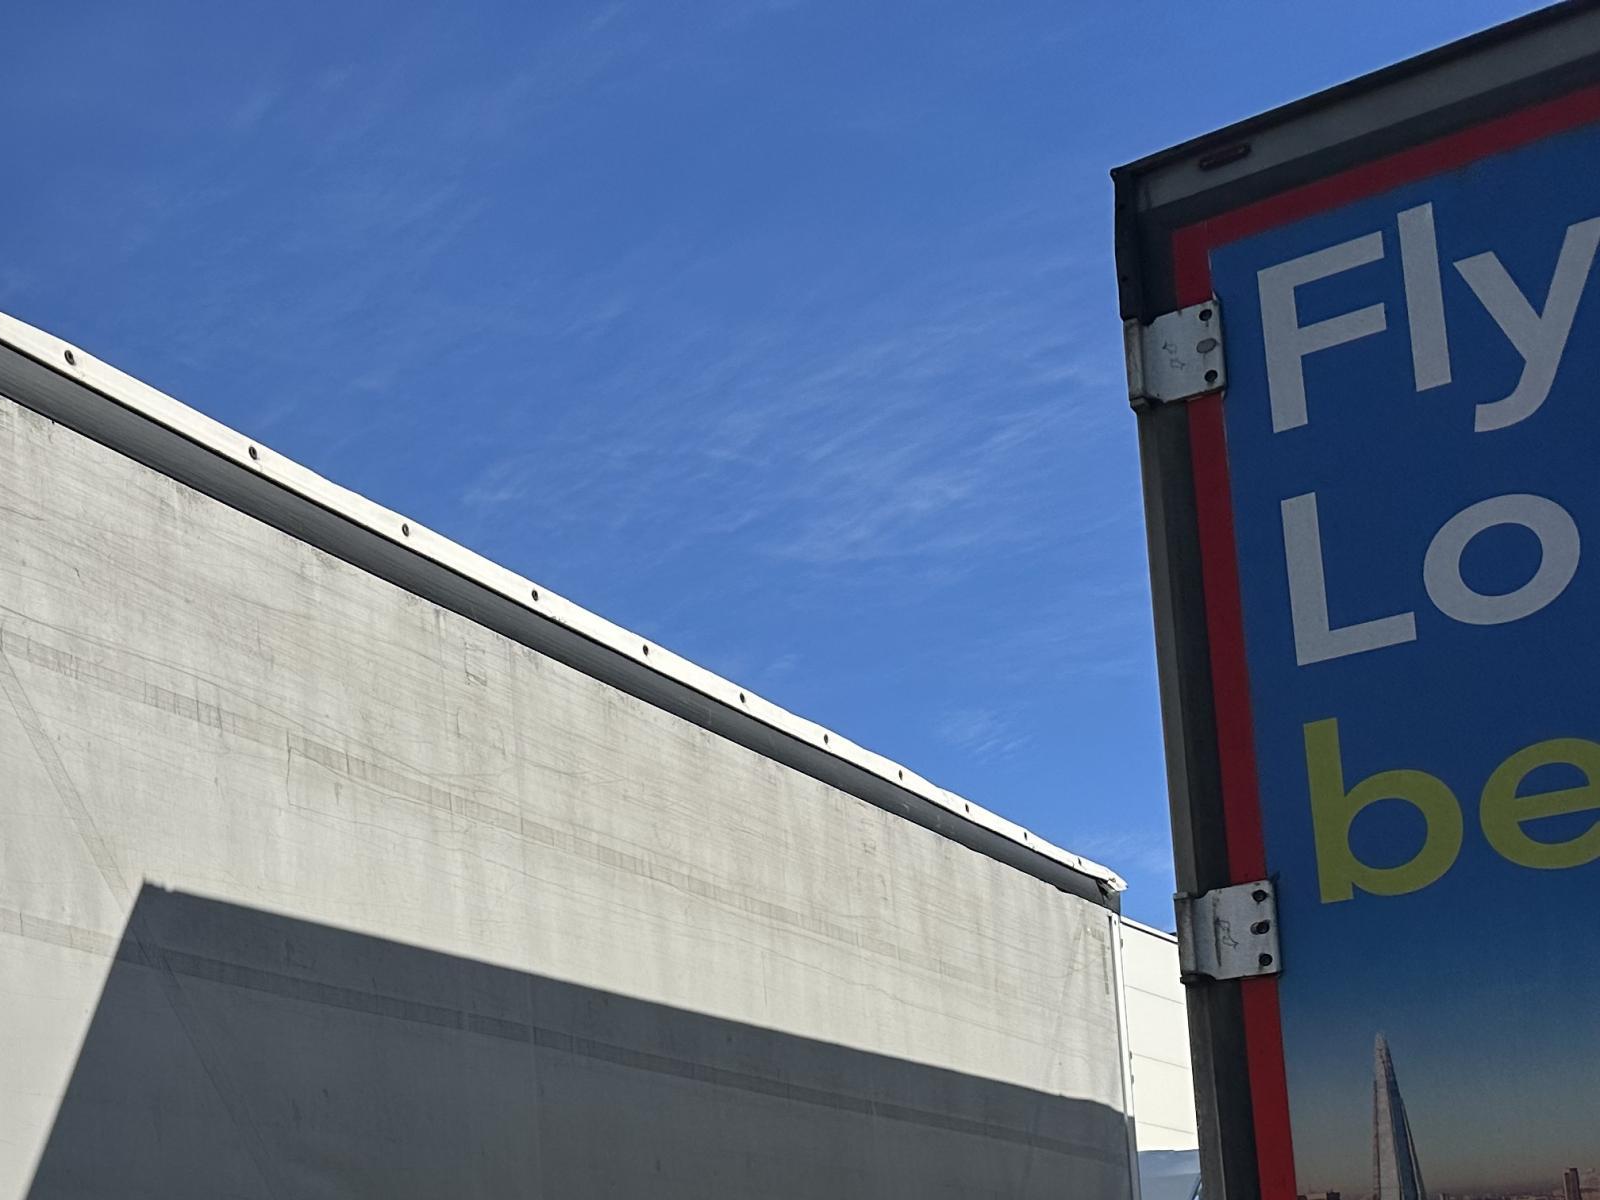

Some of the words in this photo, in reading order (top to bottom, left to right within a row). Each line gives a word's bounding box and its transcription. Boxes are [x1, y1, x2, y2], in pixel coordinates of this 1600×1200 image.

[1257, 201, 1600, 433] Fly
[1281, 492, 1581, 667] Lo
[1302, 717, 1600, 904] be
